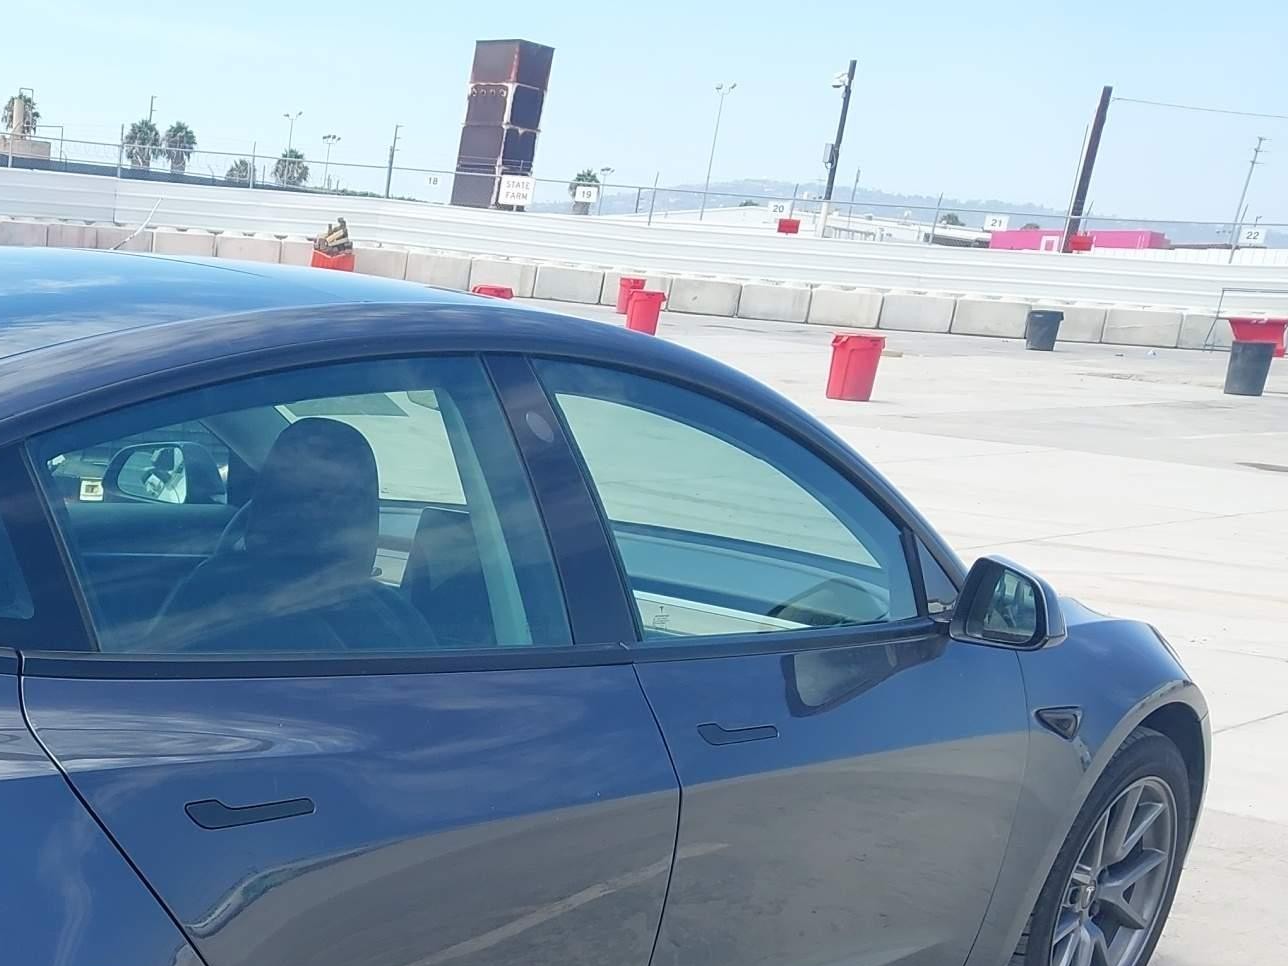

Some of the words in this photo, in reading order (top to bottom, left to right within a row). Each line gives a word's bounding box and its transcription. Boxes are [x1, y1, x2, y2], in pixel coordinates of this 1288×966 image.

[428, 176, 438, 185] 18
[506, 180, 531, 190] STATE
[505, 191, 528, 200] FARM
[581, 190, 592, 199] 19
[772, 204, 785, 213] 20
[991, 218, 1002, 228] 21
[1246, 231, 1260, 240] 22
